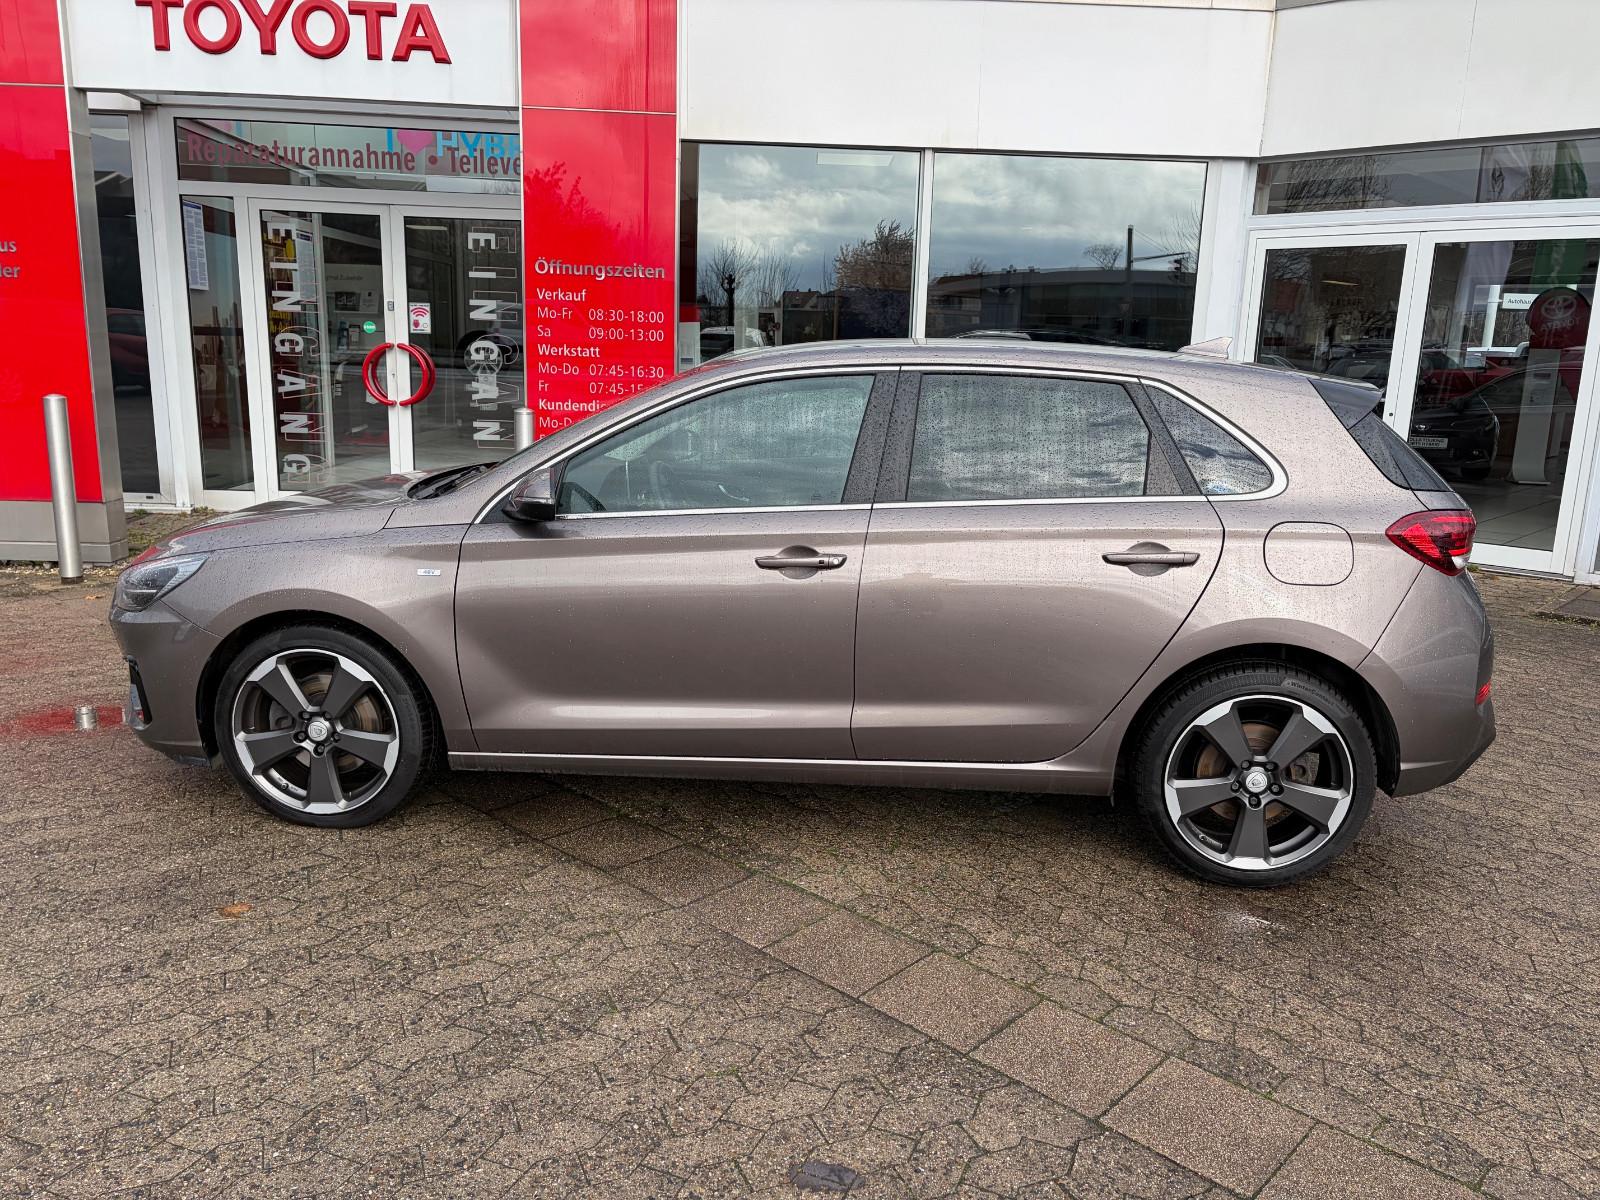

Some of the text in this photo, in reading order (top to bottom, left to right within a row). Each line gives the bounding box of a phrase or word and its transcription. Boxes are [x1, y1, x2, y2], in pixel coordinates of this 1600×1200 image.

[134, 0, 452, 64] TOYOTA
[187, 133, 416, 171] Reparaturannahme
[534, 257, 665, 280] Öffnungszeiten
[536, 288, 587, 302] Verkauf
[537, 306, 665, 323] Mo-Fr 08:30-18:00
[537, 325, 665, 342] Sa 09:00-13:00
[537, 343, 600, 358] Werkstatt
[538, 362, 665, 378] Mo-Do 07:45-16:30
[538, 380, 549, 392] Fr
[539, 416, 573, 429] Mo-D
